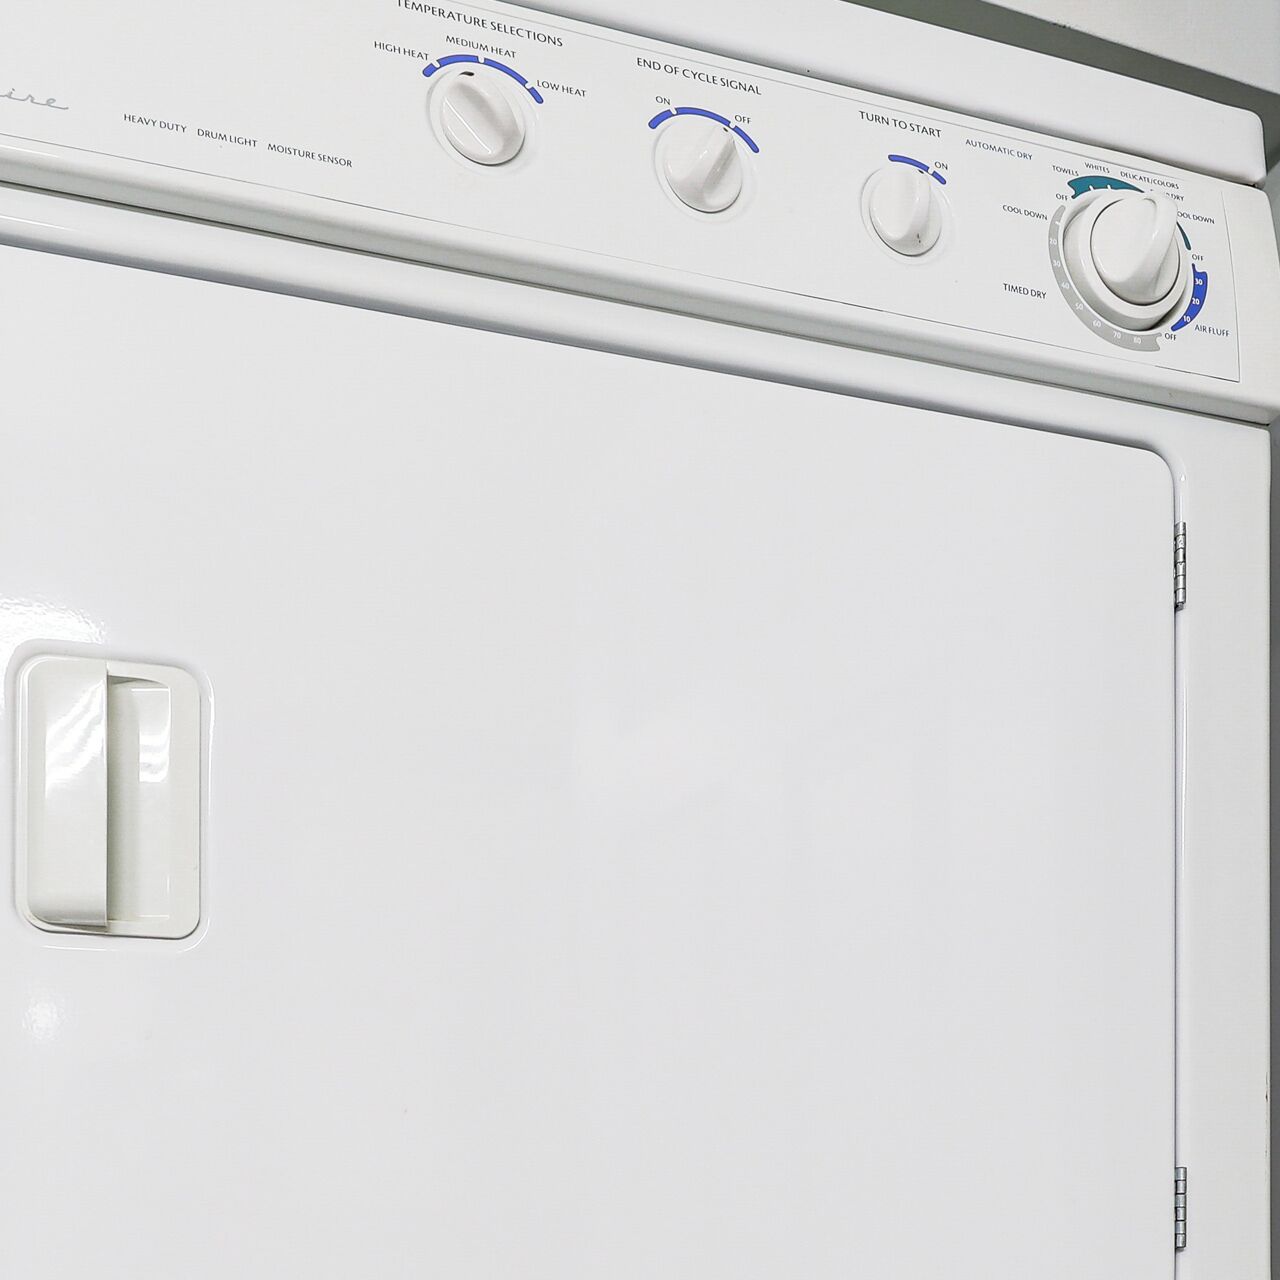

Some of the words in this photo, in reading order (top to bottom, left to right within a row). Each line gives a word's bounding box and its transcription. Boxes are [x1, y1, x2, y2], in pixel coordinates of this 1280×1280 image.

[490, 21, 563, 47] SELECTIONS
[374, 40, 401, 55] HIGH
[403, 48, 430, 61] HEAT
[445, 35, 489, 52] MEDIUM
[490, 45, 516, 59] HEAT
[637, 57, 661, 71] END
[664, 64, 680, 76] OF
[682, 68, 718, 85] CYCLE
[720, 77, 762, 95] SIGNAL
[536, 79, 560, 91] LOW
[561, 85, 586, 97] HEAT
[655, 95, 671, 106] ON
[123, 113, 157, 127] HEAVY
[159, 120, 187, 133] DUTY
[734, 114, 752, 125] OFF
[859, 110, 890, 127] TURN
[892, 118, 908, 130] TO
[909, 122, 941, 138] START
[197, 128, 228, 142] DRUM
[229, 134, 258, 147] LIGHT
[267, 143, 316, 160] MOISTURE
[317, 153, 353, 168] SENSOR
[965, 139, 1015, 157] AUTOMATIC
[1016, 151, 1033, 161] DRY
[934, 161, 949, 171] ON
[1055, 193, 1068, 201] OFF
[1002, 204, 1022, 216] COOL
[1023, 209, 1048, 221] DOWN
[1177, 211, 1192, 220] OOL
[1193, 214, 1215, 224] DOWN
[1192, 253, 1204, 262] OFF
[1003, 283, 1029, 296] TIMED
[1030, 289, 1047, 300] DRY
[1164, 333, 1177, 341] OFF
[1194, 324, 1207, 334] AIR
[1208, 326, 1230, 337] FLUFF
